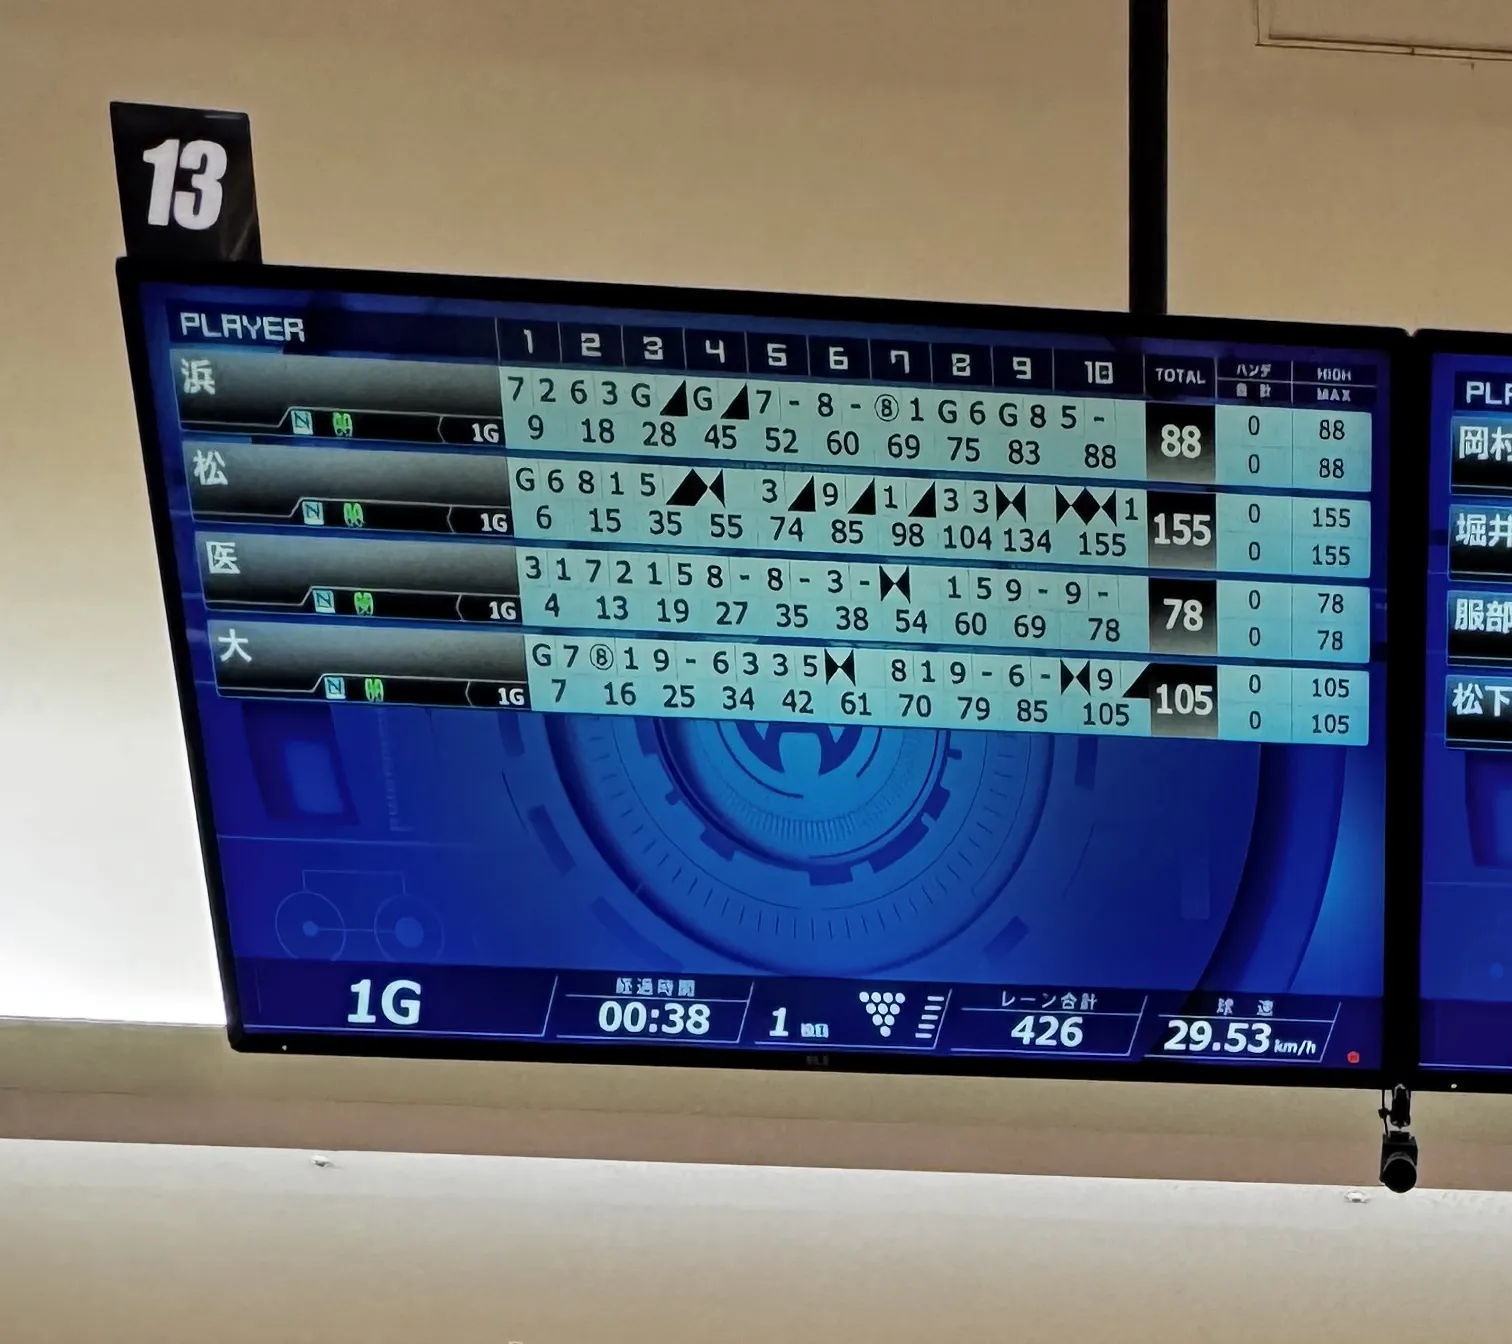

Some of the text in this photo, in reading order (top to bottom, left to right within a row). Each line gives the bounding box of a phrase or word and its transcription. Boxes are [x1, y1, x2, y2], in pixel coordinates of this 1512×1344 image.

[142, 139, 228, 230] 13
[180, 312, 305, 342] PLAYER
[523, 329, 533, 354] 1
[581, 332, 602, 357] 2
[643, 336, 664, 360] 3
[705, 340, 725, 363] 4
[767, 343, 787, 366] 5
[829, 346, 848, 370] 6
[951, 353, 971, 376] 8
[1012, 356, 1032, 380] 9
[1084, 361, 1114, 384] 10
[1155, 368, 1206, 384] TOTAL
[180, 357, 216, 395] 浜
[1317, 387, 1351, 402] MAX
[472, 418, 1202, 469] 1G 18 28 45 52 60 69 75 83 88 88
[192, 449, 228, 485] 松
[480, 508, 1212, 557] 1G 15 35 55 74 85 98 104 134 155 155
[205, 540, 240, 574] 医
[489, 595, 1203, 642] 1G 13 19 27 35 38 54 60 69 78 78
[217, 628, 252, 662] 大
[498, 681, 1213, 727] 1G 16 25 34 42 61 70 79 85 105 105
[348, 979, 421, 1025] 1G
[598, 1000, 710, 1035] 00:38
[1002, 990, 1098, 1010] レーン合計
[769, 1007, 789, 1037] 1
[1011, 1015, 1083, 1047] 426
[1164, 1020, 1272, 1053] 29.53
